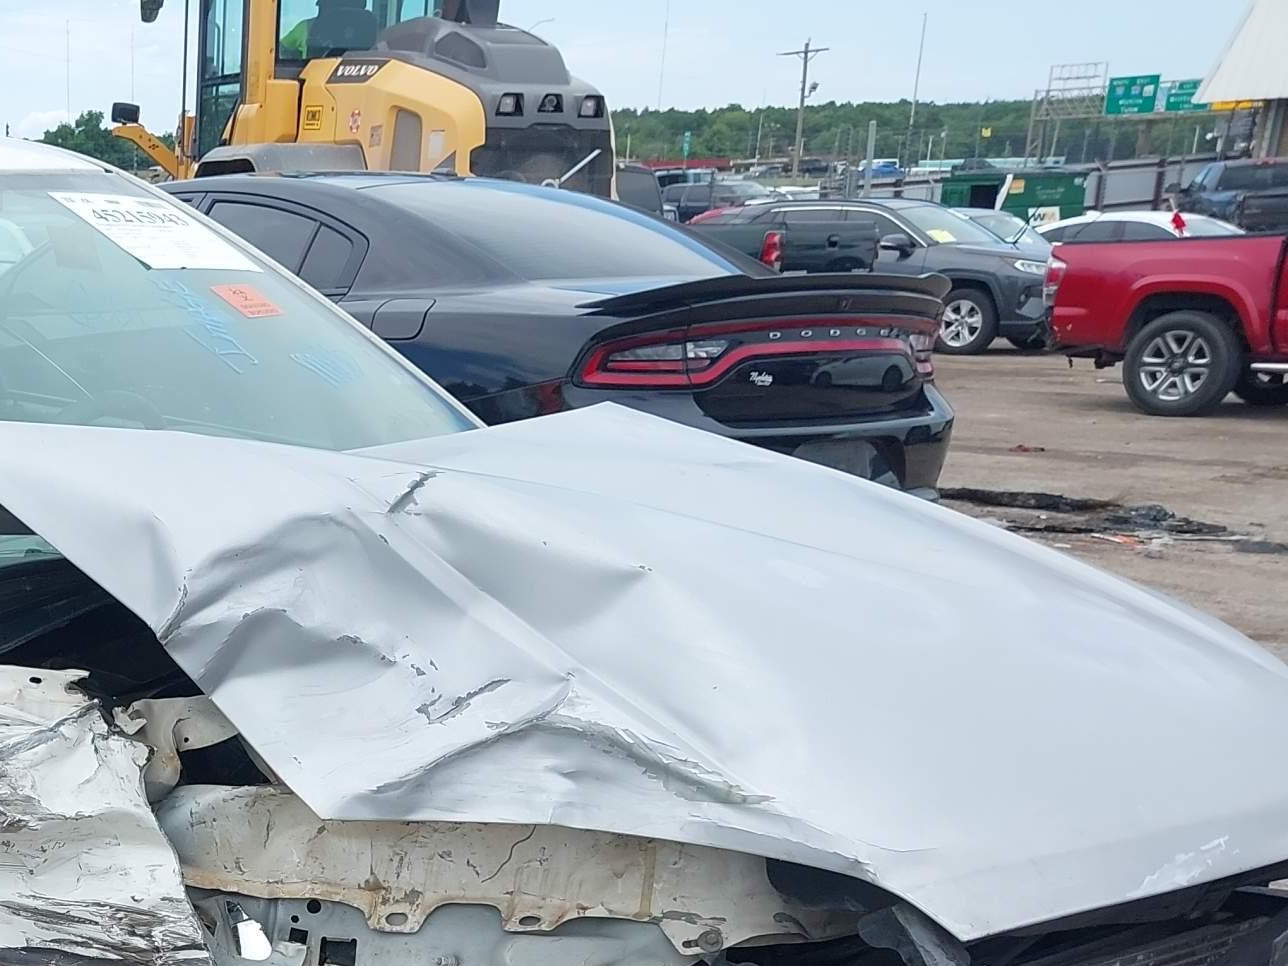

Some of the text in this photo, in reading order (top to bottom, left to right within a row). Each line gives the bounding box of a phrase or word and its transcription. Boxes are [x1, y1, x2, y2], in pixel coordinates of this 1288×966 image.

[336, 64, 380, 77] VOLVO
[92, 208, 190, 227] 45215943
[769, 328, 890, 340] DODGE
